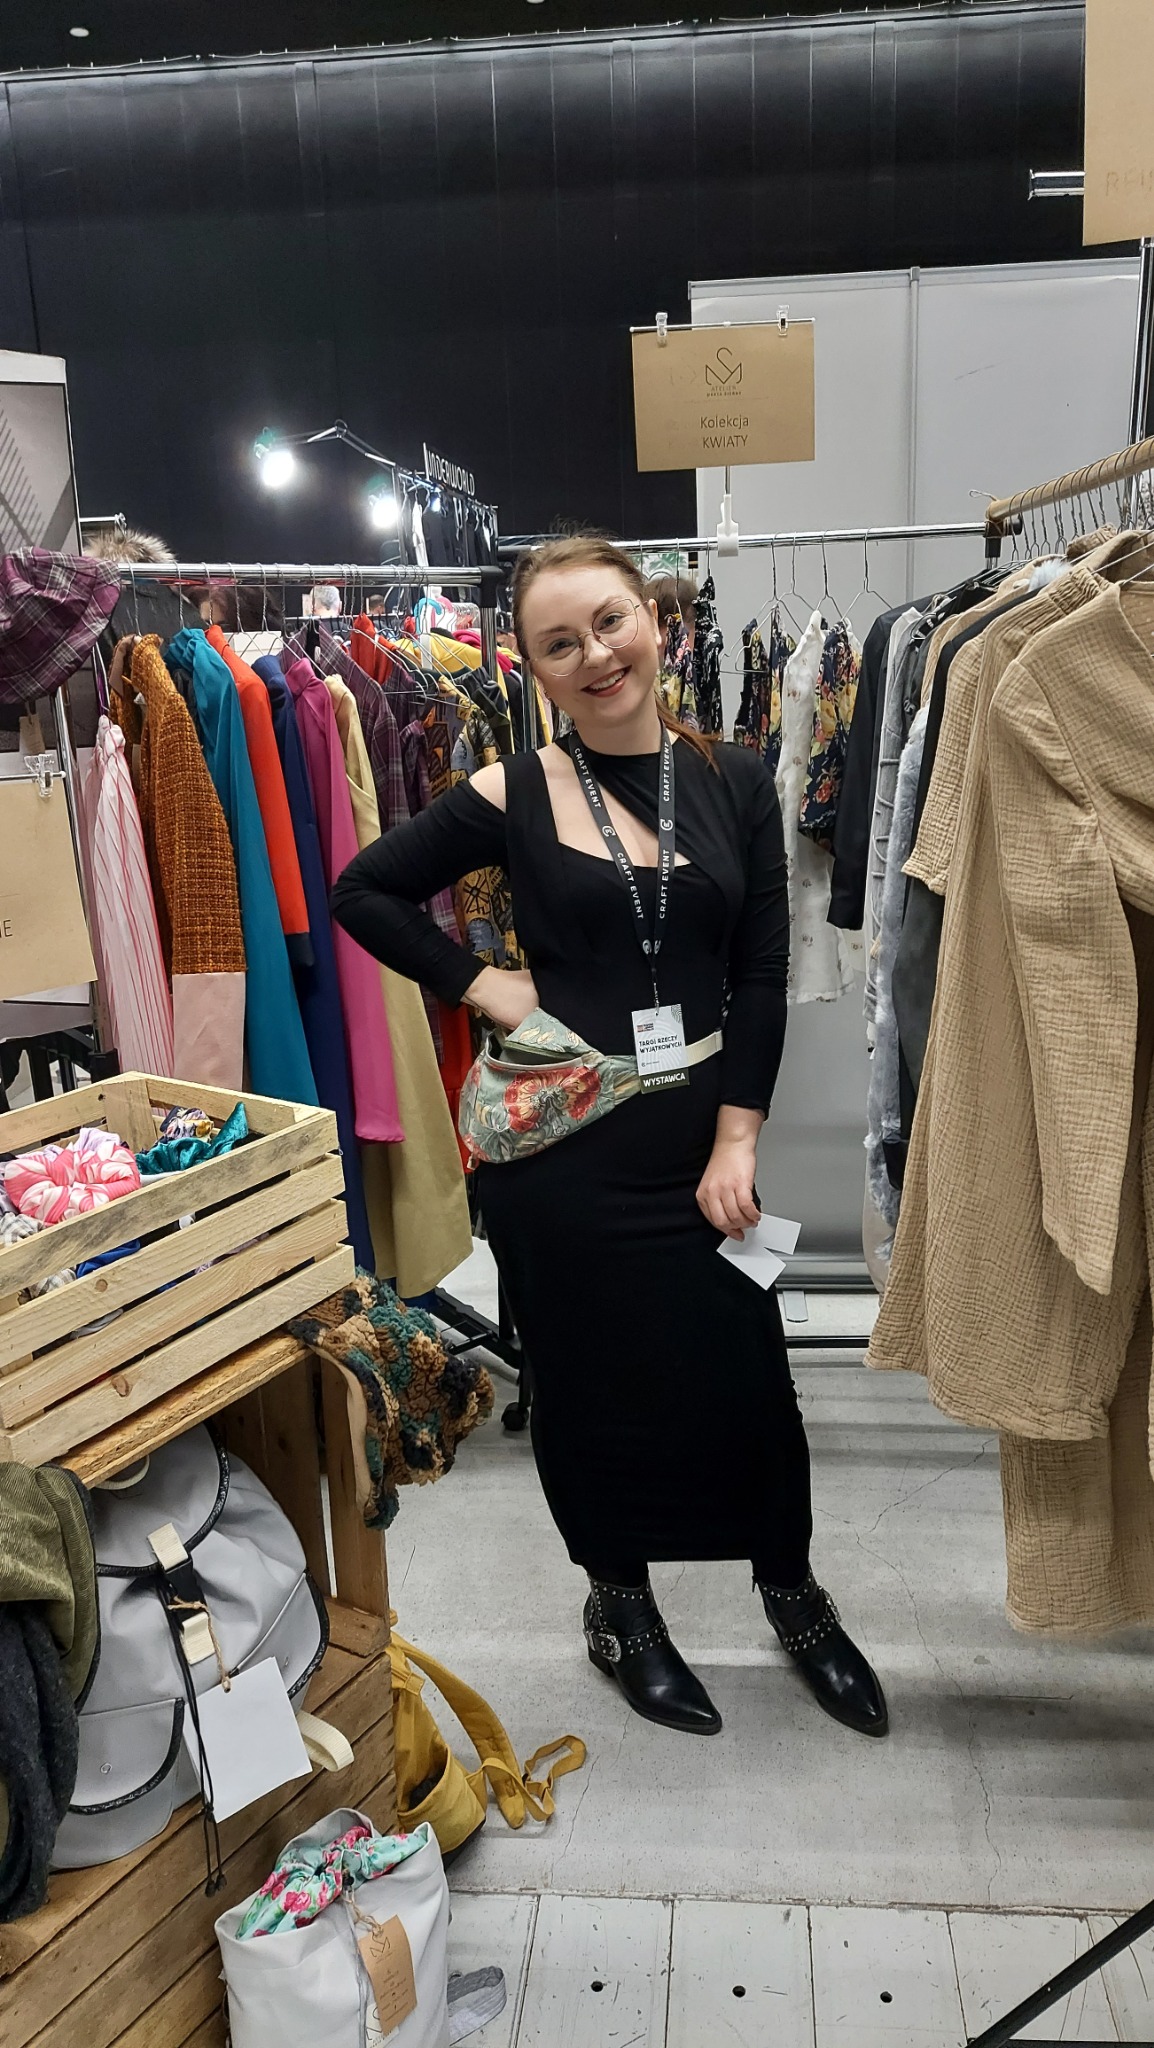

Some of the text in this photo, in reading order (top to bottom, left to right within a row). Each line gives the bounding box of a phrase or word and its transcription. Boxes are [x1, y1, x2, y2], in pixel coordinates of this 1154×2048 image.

[700, 414, 749, 430] Kolekcja
[702, 435, 749, 449] KWIATY
[574, 747, 601, 808] CRAFT EVENT
[616, 852, 644, 919] CRAFT EVENT
[659, 849, 670, 919] CRAFT EVENT
[657, 1035, 678, 1044] RZECZY
[643, 1072, 686, 1087] WYSTAWCA
